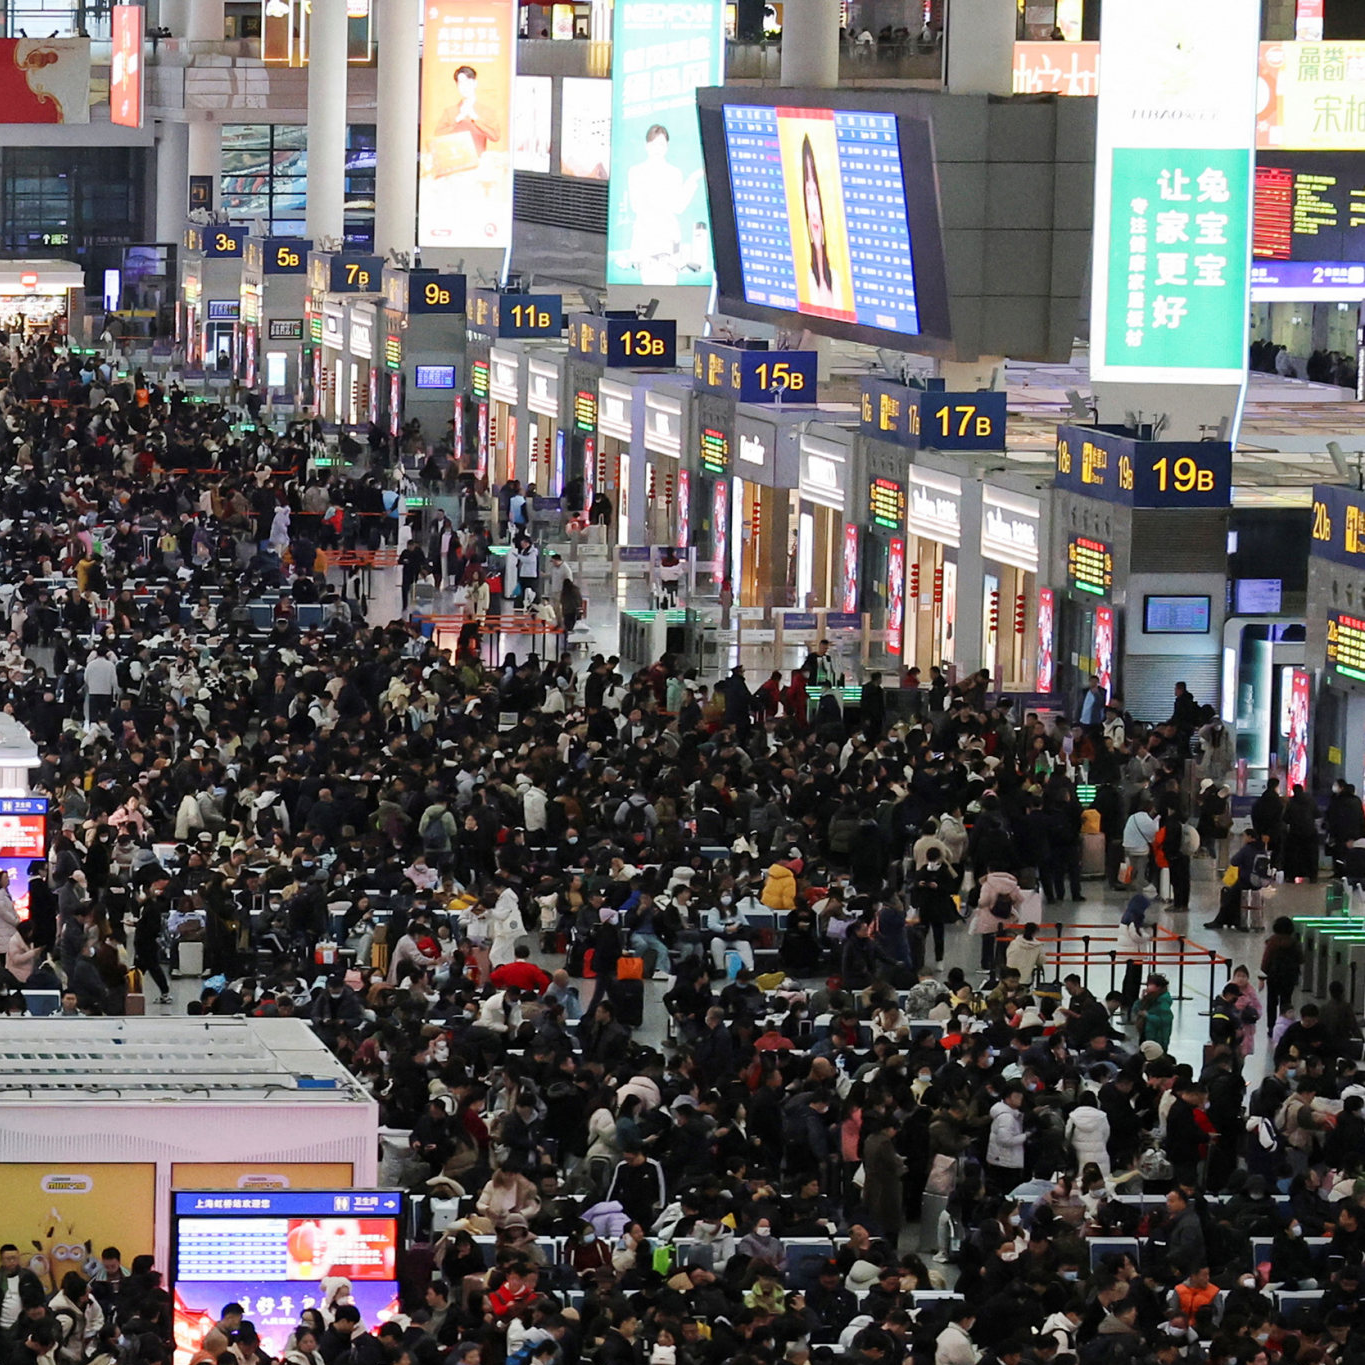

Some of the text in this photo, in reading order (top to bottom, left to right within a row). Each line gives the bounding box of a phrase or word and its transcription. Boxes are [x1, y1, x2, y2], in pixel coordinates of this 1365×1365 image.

[1193, 167, 1230, 287] 兔宝宝
[215, 233, 236, 251] 3B
[1152, 168, 1192, 330] 让家更好
[277, 247, 300, 267] 5B
[345, 264, 369, 285] 7B
[1312, 267, 1323, 283] 2
[425, 283, 450, 305] 9B
[511, 305, 551, 328] 11B
[620, 330, 665, 356] 13B
[755, 362, 804, 390] 15B
[935, 405, 992, 437] 17B
[1055, 438, 1072, 474] 18B
[1118, 456, 1134, 491] 19B
[1152, 457, 1214, 492] 19B
[1311, 501, 1332, 541] 20B
[354, 1197, 379, 1206] 卫生间
